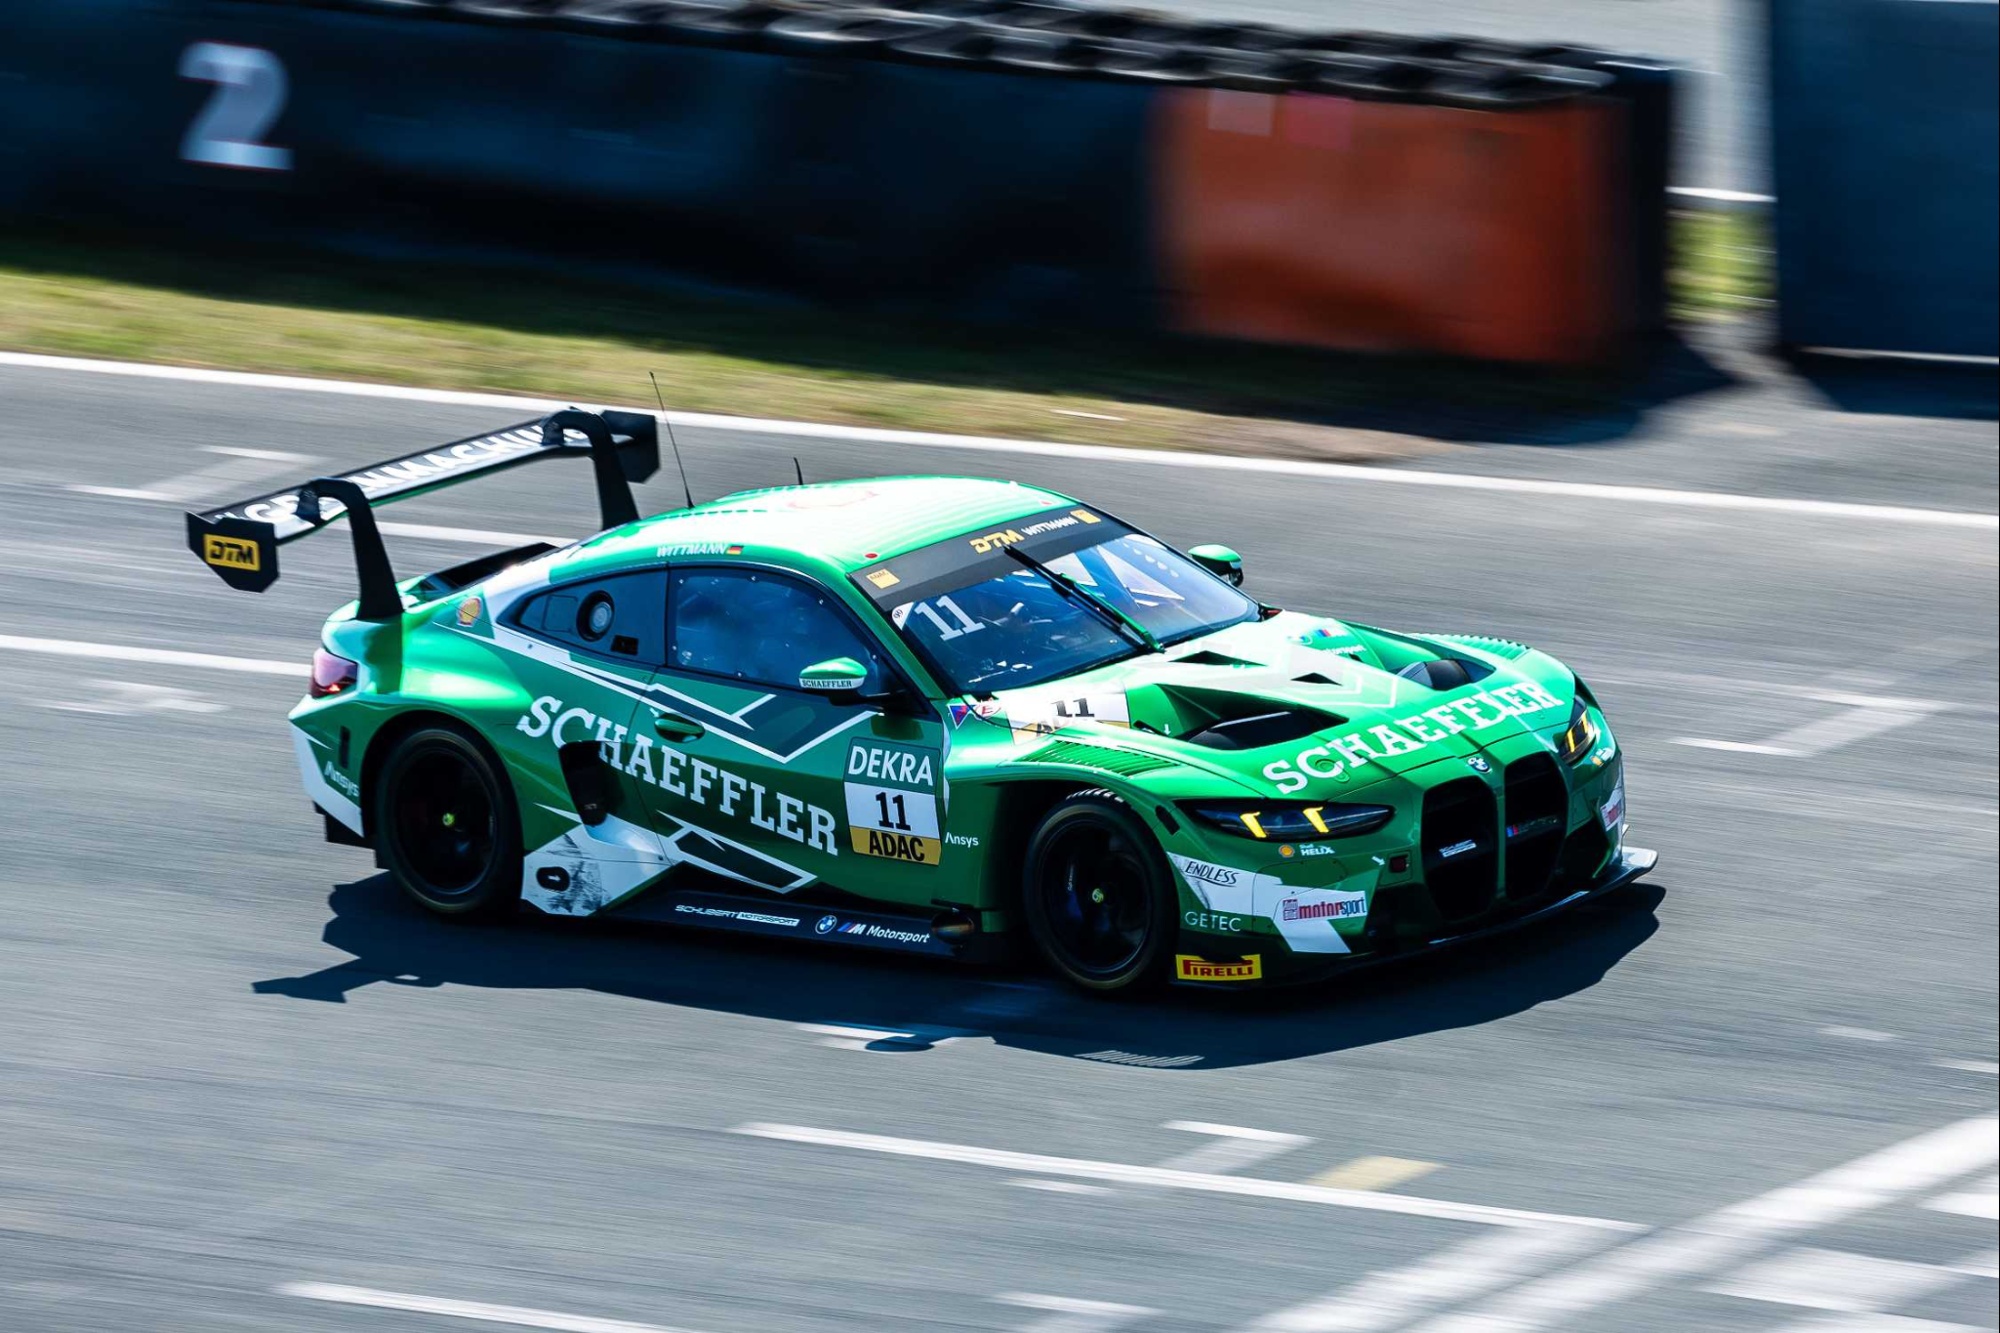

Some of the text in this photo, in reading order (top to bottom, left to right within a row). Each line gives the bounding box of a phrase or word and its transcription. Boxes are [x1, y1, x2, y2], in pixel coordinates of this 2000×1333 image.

[177, 41, 296, 171] 2
[969, 516, 1080, 554] DTM WITTMANN
[209, 539, 256, 566] DTM
[657, 542, 725, 558] WITTMANN
[913, 595, 986, 642] 11
[801, 679, 853, 688] SCHAEFFLER
[1050, 697, 1096, 718] 11
[1262, 683, 1565, 795] SCHAEFFLER
[516, 695, 838, 856] SCHAEFFLER
[848, 745, 934, 787] DEKRA
[875, 791, 912, 832] 11
[869, 829, 926, 863] ADAC
[945, 831, 979, 849] Ansys
[1301, 846, 1336, 856] HELIX
[1185, 860, 1241, 885] ENDLESS
[675, 904, 799, 927] SCHUBERT MOTORSPORT
[1299, 896, 1367, 919] motorsport
[1184, 911, 1242, 931] GETEC
[866, 924, 931, 944] Motorsport
[1182, 959, 1254, 977] PIRELLI
